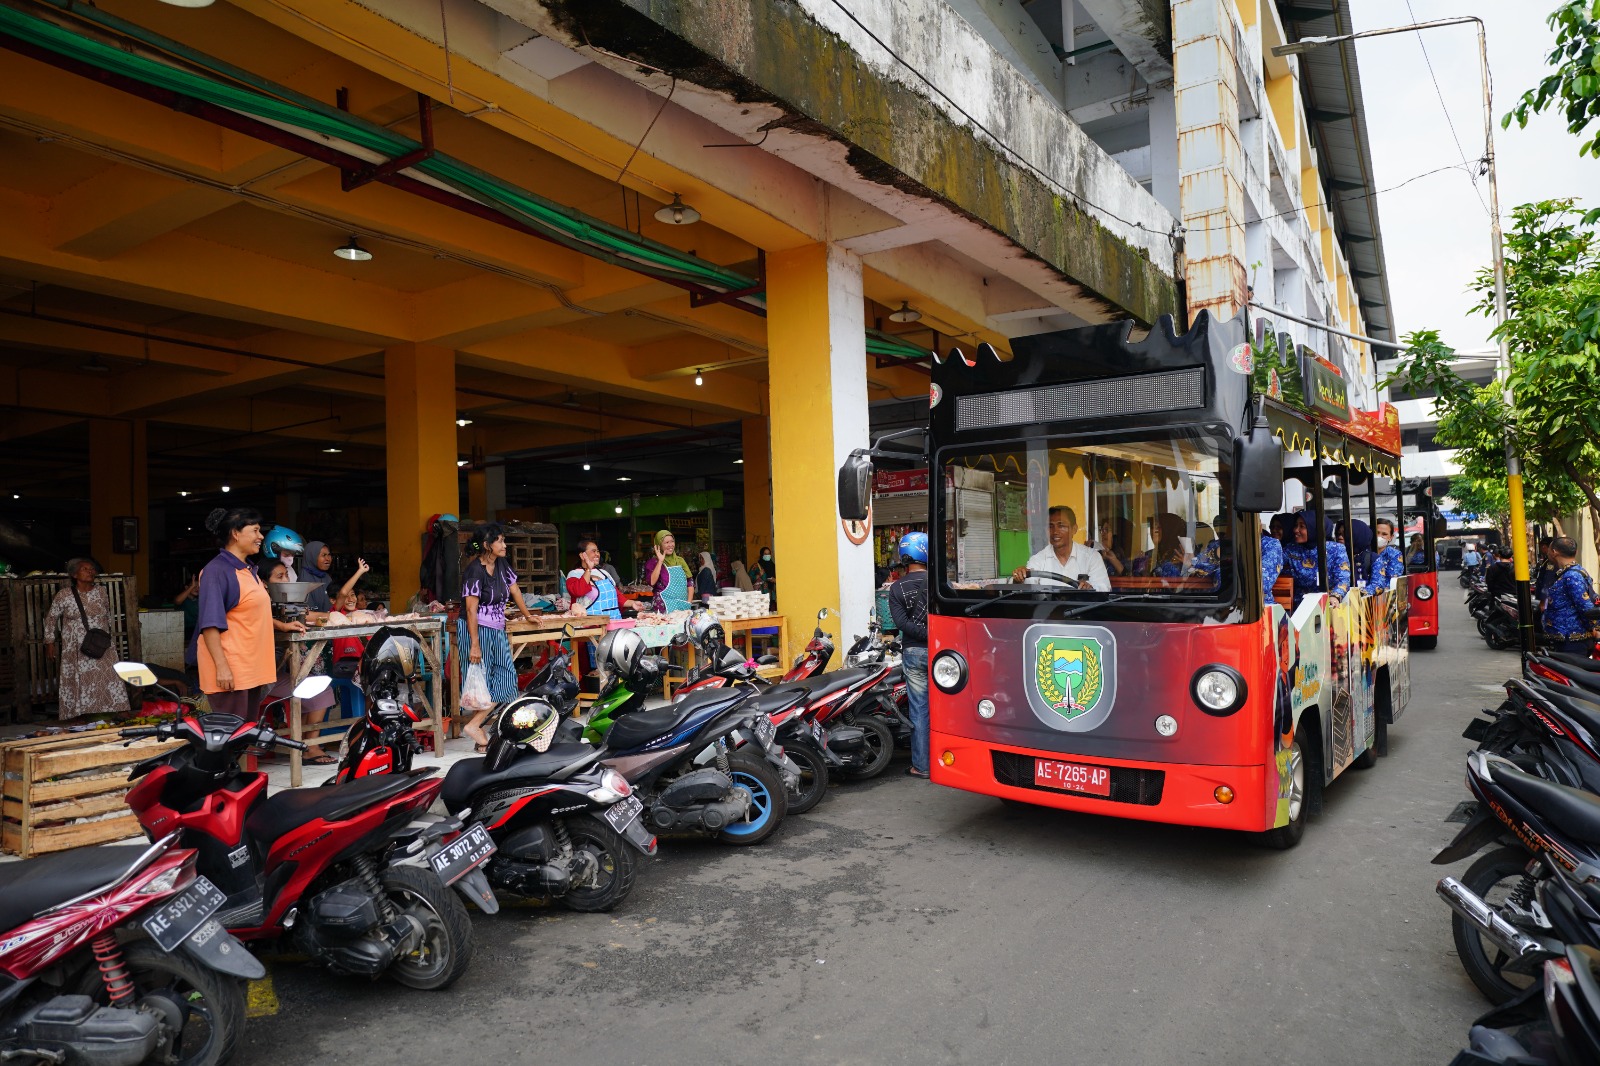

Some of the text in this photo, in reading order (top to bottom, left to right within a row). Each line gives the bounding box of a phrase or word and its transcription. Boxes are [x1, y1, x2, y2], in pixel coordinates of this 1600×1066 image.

[1038, 761, 1107, 785] AE 7265 AP
[436, 830, 485, 871] AE 3072 DC
[150, 878, 214, 936] AE 5921 BE
